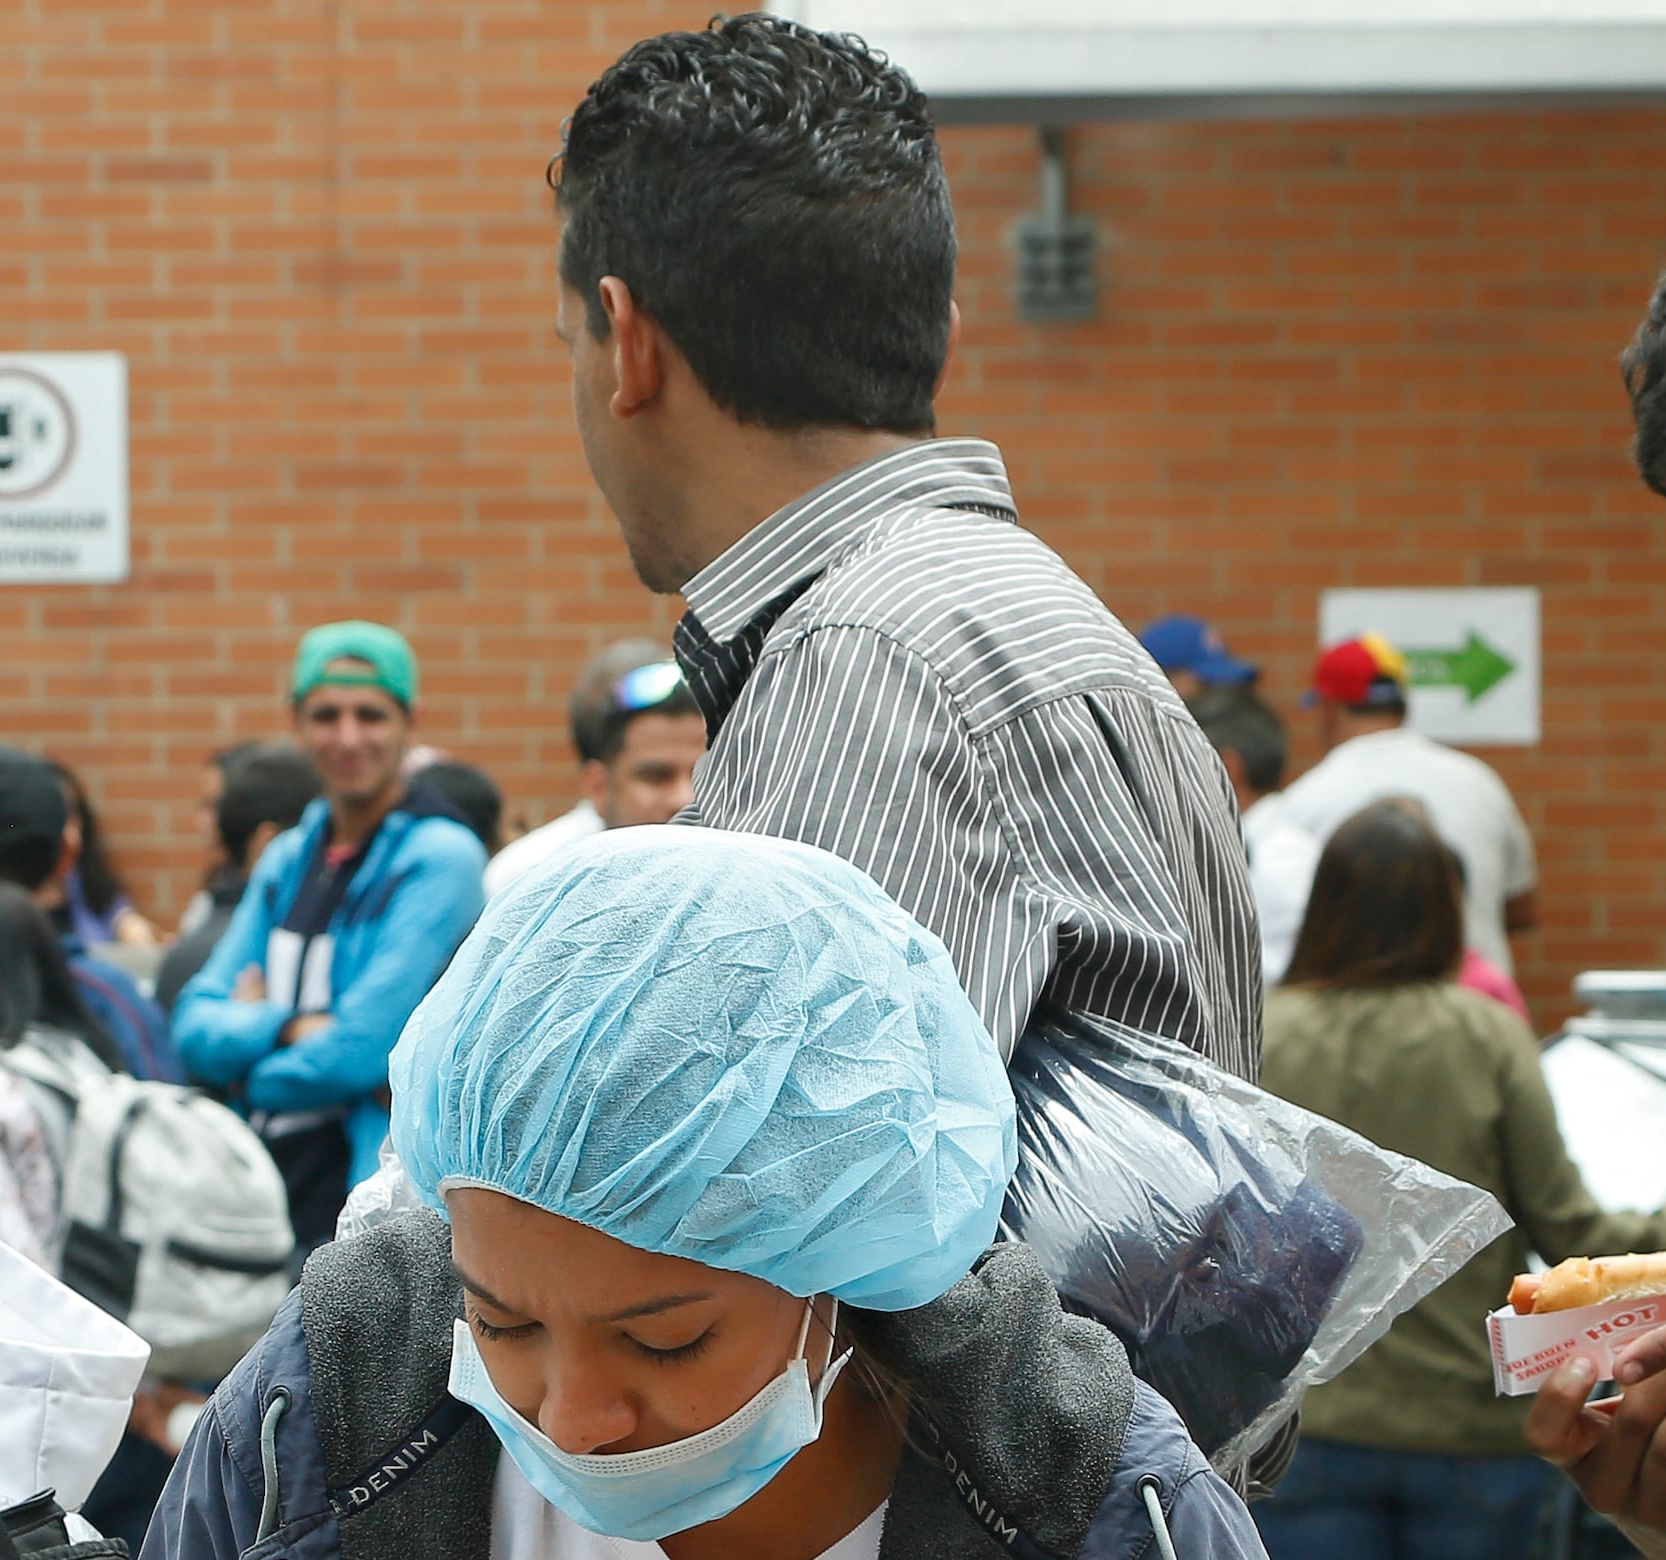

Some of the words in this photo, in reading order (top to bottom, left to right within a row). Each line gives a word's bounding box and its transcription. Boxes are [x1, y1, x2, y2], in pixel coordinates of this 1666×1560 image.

[1586, 1305, 1658, 1340] HOT
[348, 1429, 438, 1506] DENIM
[944, 1450, 1018, 1545] DENIM
